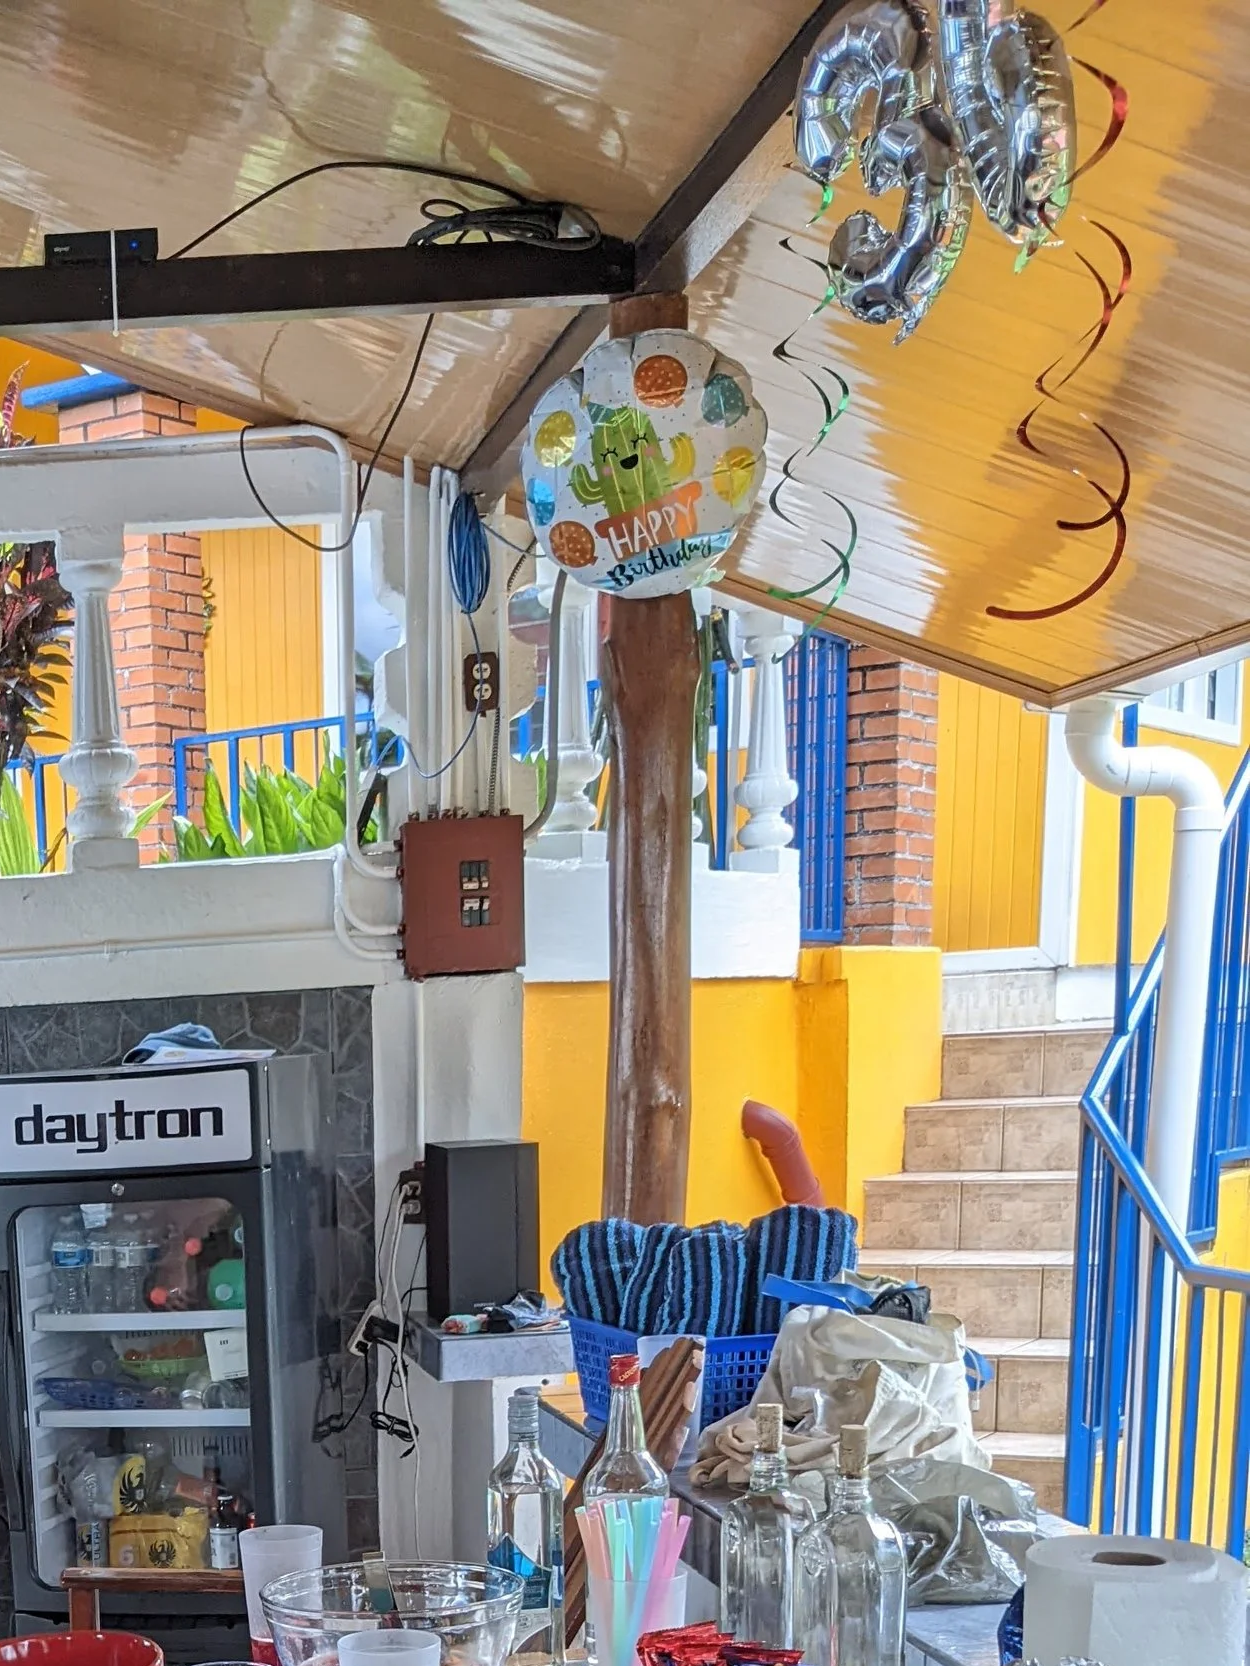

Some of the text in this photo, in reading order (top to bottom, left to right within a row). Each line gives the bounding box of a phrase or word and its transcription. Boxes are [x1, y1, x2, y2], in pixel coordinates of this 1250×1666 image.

[608, 496, 693, 559] HAPPY
[607, 537, 712, 587] Birthday
[15, 1100, 224, 1154] daytron
